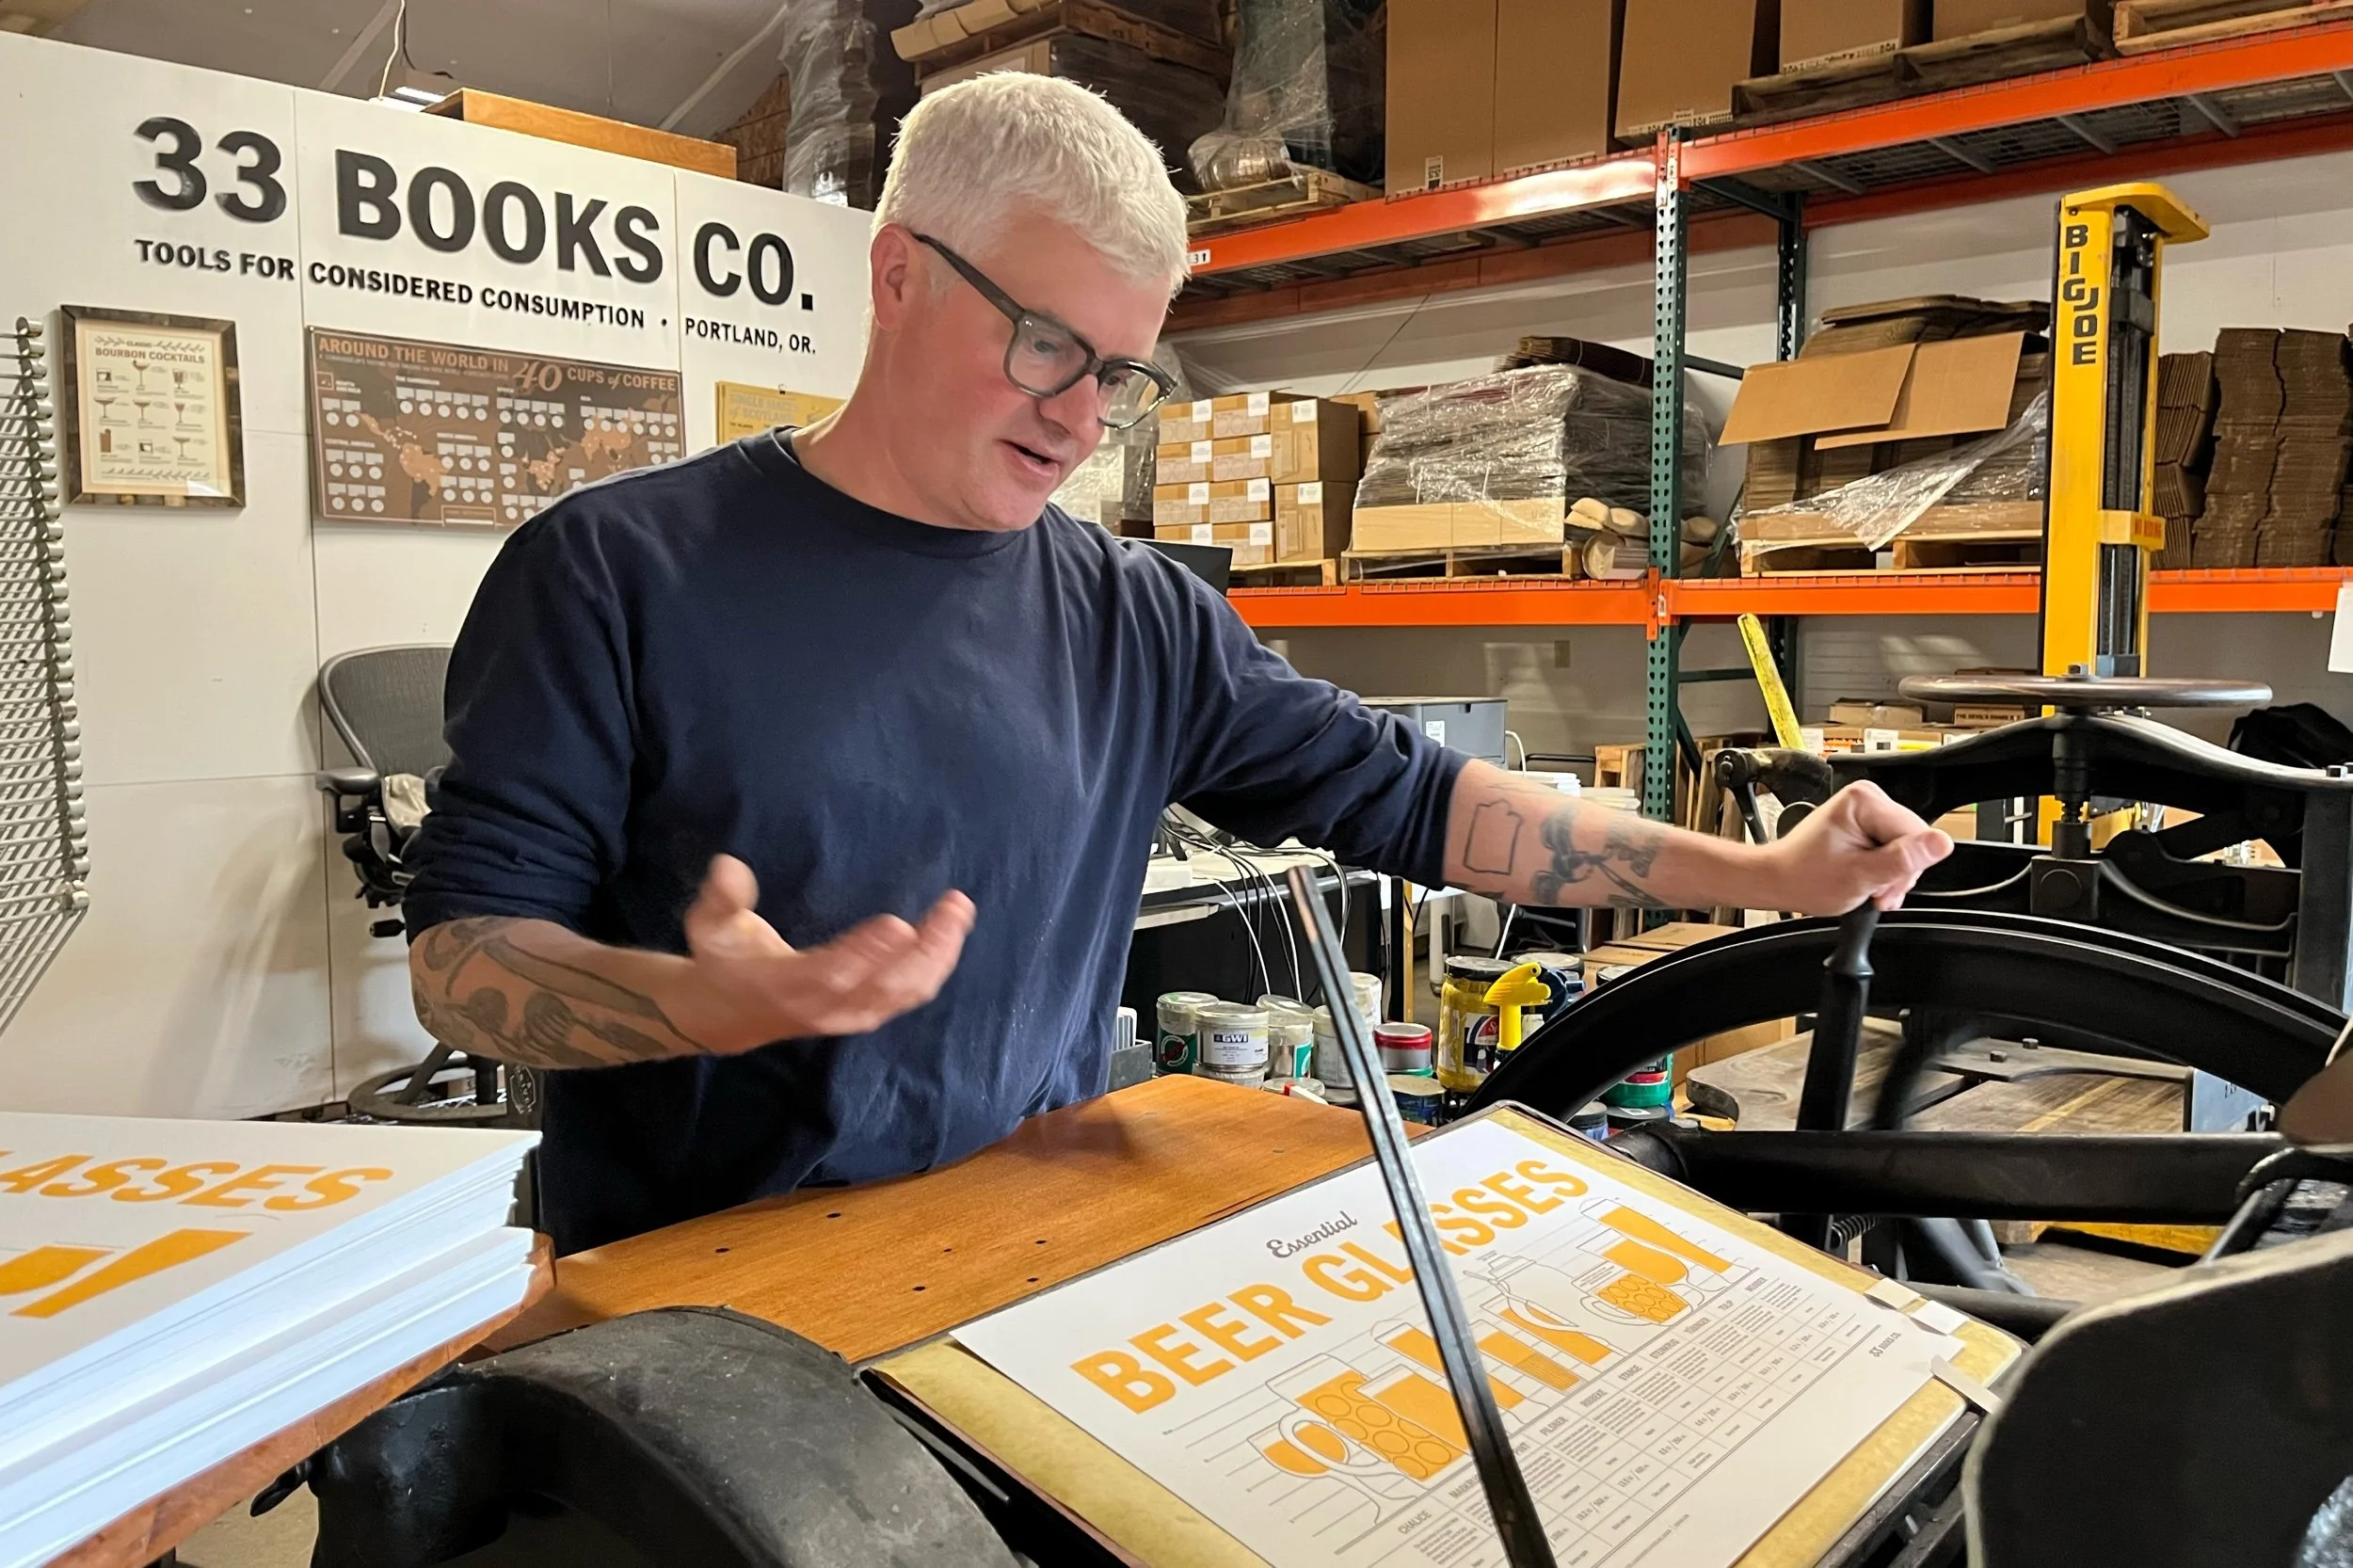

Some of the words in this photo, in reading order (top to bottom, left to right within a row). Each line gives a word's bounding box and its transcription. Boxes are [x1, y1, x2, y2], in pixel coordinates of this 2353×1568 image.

[132, 116, 287, 223] 33
[335, 148, 664, 283] BOOKS
[694, 222, 814, 312] CO.
[2063, 224, 2089, 301] BIG
[135, 239, 232, 272] TOOLS
[241, 253, 296, 281] FOR
[309, 262, 472, 305] CONSIDERED
[481, 287, 645, 329] CONSUMPTION
[684, 317, 783, 353] PORTLAND,
[789, 335, 817, 355] OR.
[2073, 287, 2100, 365] JOE
[95, 347, 147, 360] BOURBON
[149, 351, 205, 365] COCKTAILS
[319, 337, 390, 360] AROUND
[394, 346, 426, 364] THE
[431, 351, 488, 370] WORLD
[492, 358, 509, 373] IN
[512, 360, 563, 392] 40
[567, 366, 604, 385] CUPS
[622, 373, 677, 392] COFFEE
[1222, 1034, 1249, 1043] GWI
[0, 1150, 393, 1210] ASSES
[1266, 1209, 1358, 1258] Essential
[1069, 1283, 1334, 1416] BEER
[1539, 1416, 1568, 1436] PILSNER
[1398, 1510, 1433, 1535] CHALICE
